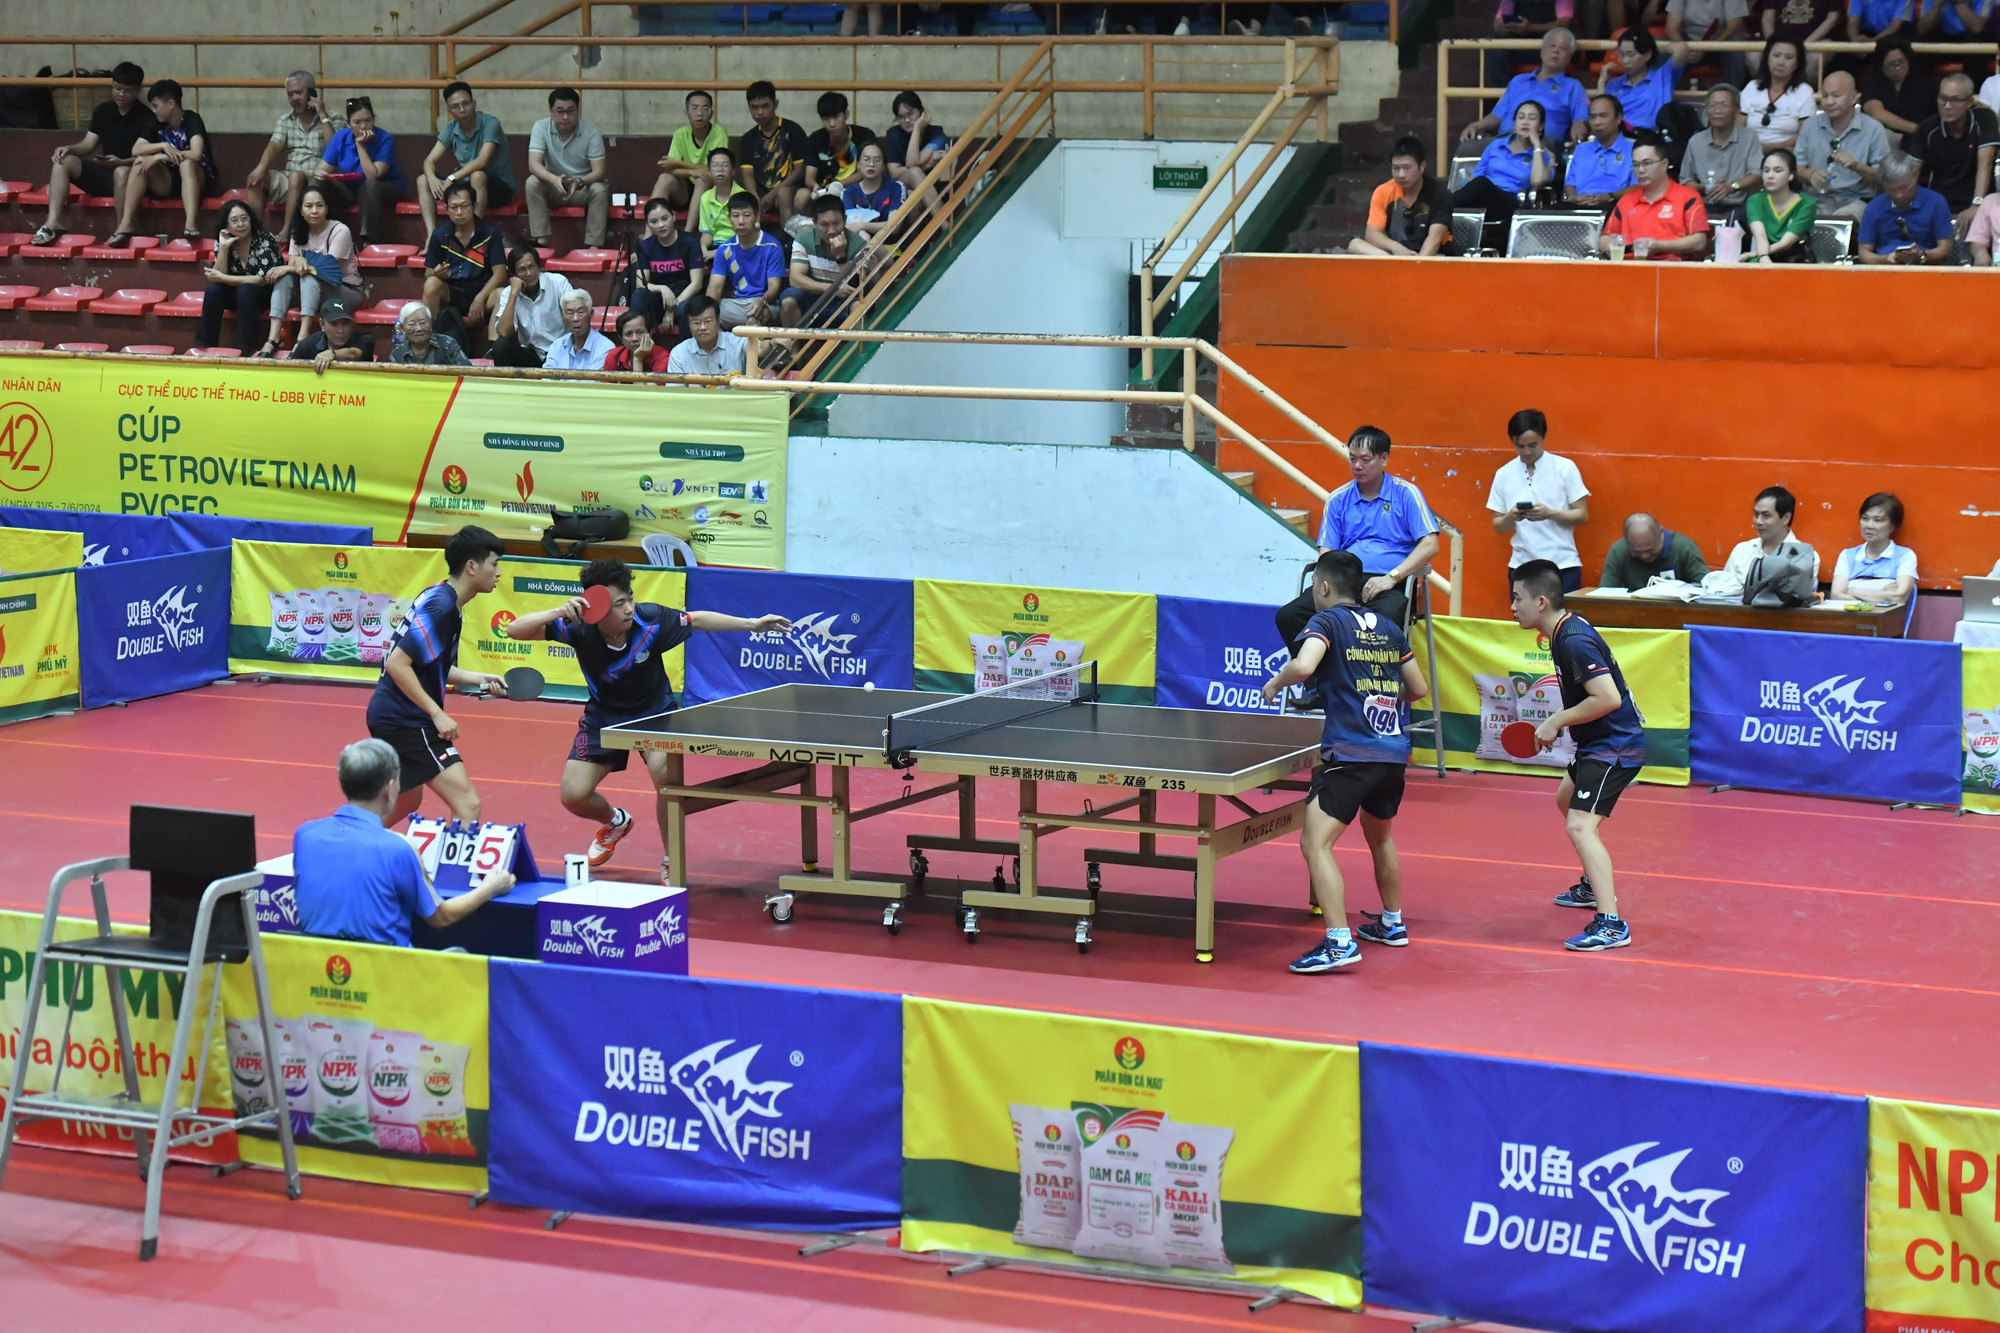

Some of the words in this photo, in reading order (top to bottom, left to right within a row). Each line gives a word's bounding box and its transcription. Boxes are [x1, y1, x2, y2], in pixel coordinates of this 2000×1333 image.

[2, 376, 34, 391] NHÂN
[37, 377, 61, 392] DÂN
[118, 384, 143, 398] CỤC
[147, 379, 171, 397] THỂ
[173, 386, 198, 401] DỤC
[202, 381, 226, 399] THỂ
[229, 388, 260, 401] THAO
[272, 390, 304, 404] LĐBB
[309, 389, 336, 407] VIỆT
[339, 394, 366, 407] NAM
[118, 405, 181, 443] CÚP
[119, 453, 356, 493] PETROVIETNAM
[581, 491, 600, 502] NPK
[686, 485, 716, 493] VNPT
[720, 487, 737, 495] BIDV
[501, 501, 557, 514] PETROVIETNAM
[527, 581, 543, 591] NHÀ
[277, 614, 298, 623] NPK
[304, 616, 324, 625] NPK
[332, 613, 353, 622] NPK
[362, 616, 382, 626] NPK
[44, 644, 58, 656] NPK
[116, 634, 165, 660] DOUBLE
[179, 626, 204, 648] FISH
[739, 647, 804, 672] DOUBLE
[831, 657, 867, 676] FISH
[1224, 647, 1262, 676] 双魚
[983, 673, 1003, 681] DAP
[1760, 680, 1801, 711] 双魚
[1490, 713, 1514, 723] DAP
[1740, 716, 1824, 747] DOUBLE
[1850, 729, 1898, 751] FISH
[1973, 736, 1999, 746] NPK
[717, 748, 739, 757] Double
[740, 750, 755, 758] FISH
[770, 748, 864, 767] MOFIT
[989, 765, 1078, 783] 世乒赛器材供应商
[1122, 775, 1147, 788] 双鱼
[1161, 779, 1186, 791] 235
[1275, 813, 1293, 830] FISH
[476, 837, 505, 870] 5
[572, 861, 585, 880] T
[543, 939, 584, 955] Double
[600, 946, 625, 959] FISH
[635, 939, 662, 958] Double
[671, 932, 686, 946] FISH
[235, 1056, 262, 1071] NPK
[322, 1062, 358, 1077] NPK
[604, 1045, 668, 1095] 双魚
[373, 1072, 409, 1088] NPK
[428, 1075, 451, 1085] NPK
[1146, 1076, 1163, 1090] MAU
[574, 1101, 703, 1152] DOUBLE
[742, 1125, 811, 1161] FISH
[1499, 1141, 1574, 1199] 双魚
[1034, 1172, 1074, 1189] DAP
[1052, 1189, 1075, 1201] MAU
[1164, 1188, 1208, 1205] KALI
[1177, 1203, 1198, 1214] MAU
[1173, 1213, 1200, 1222] MOP
[1463, 1201, 1615, 1262] DOUBLE
[1661, 1235, 1747, 1278] FISH
